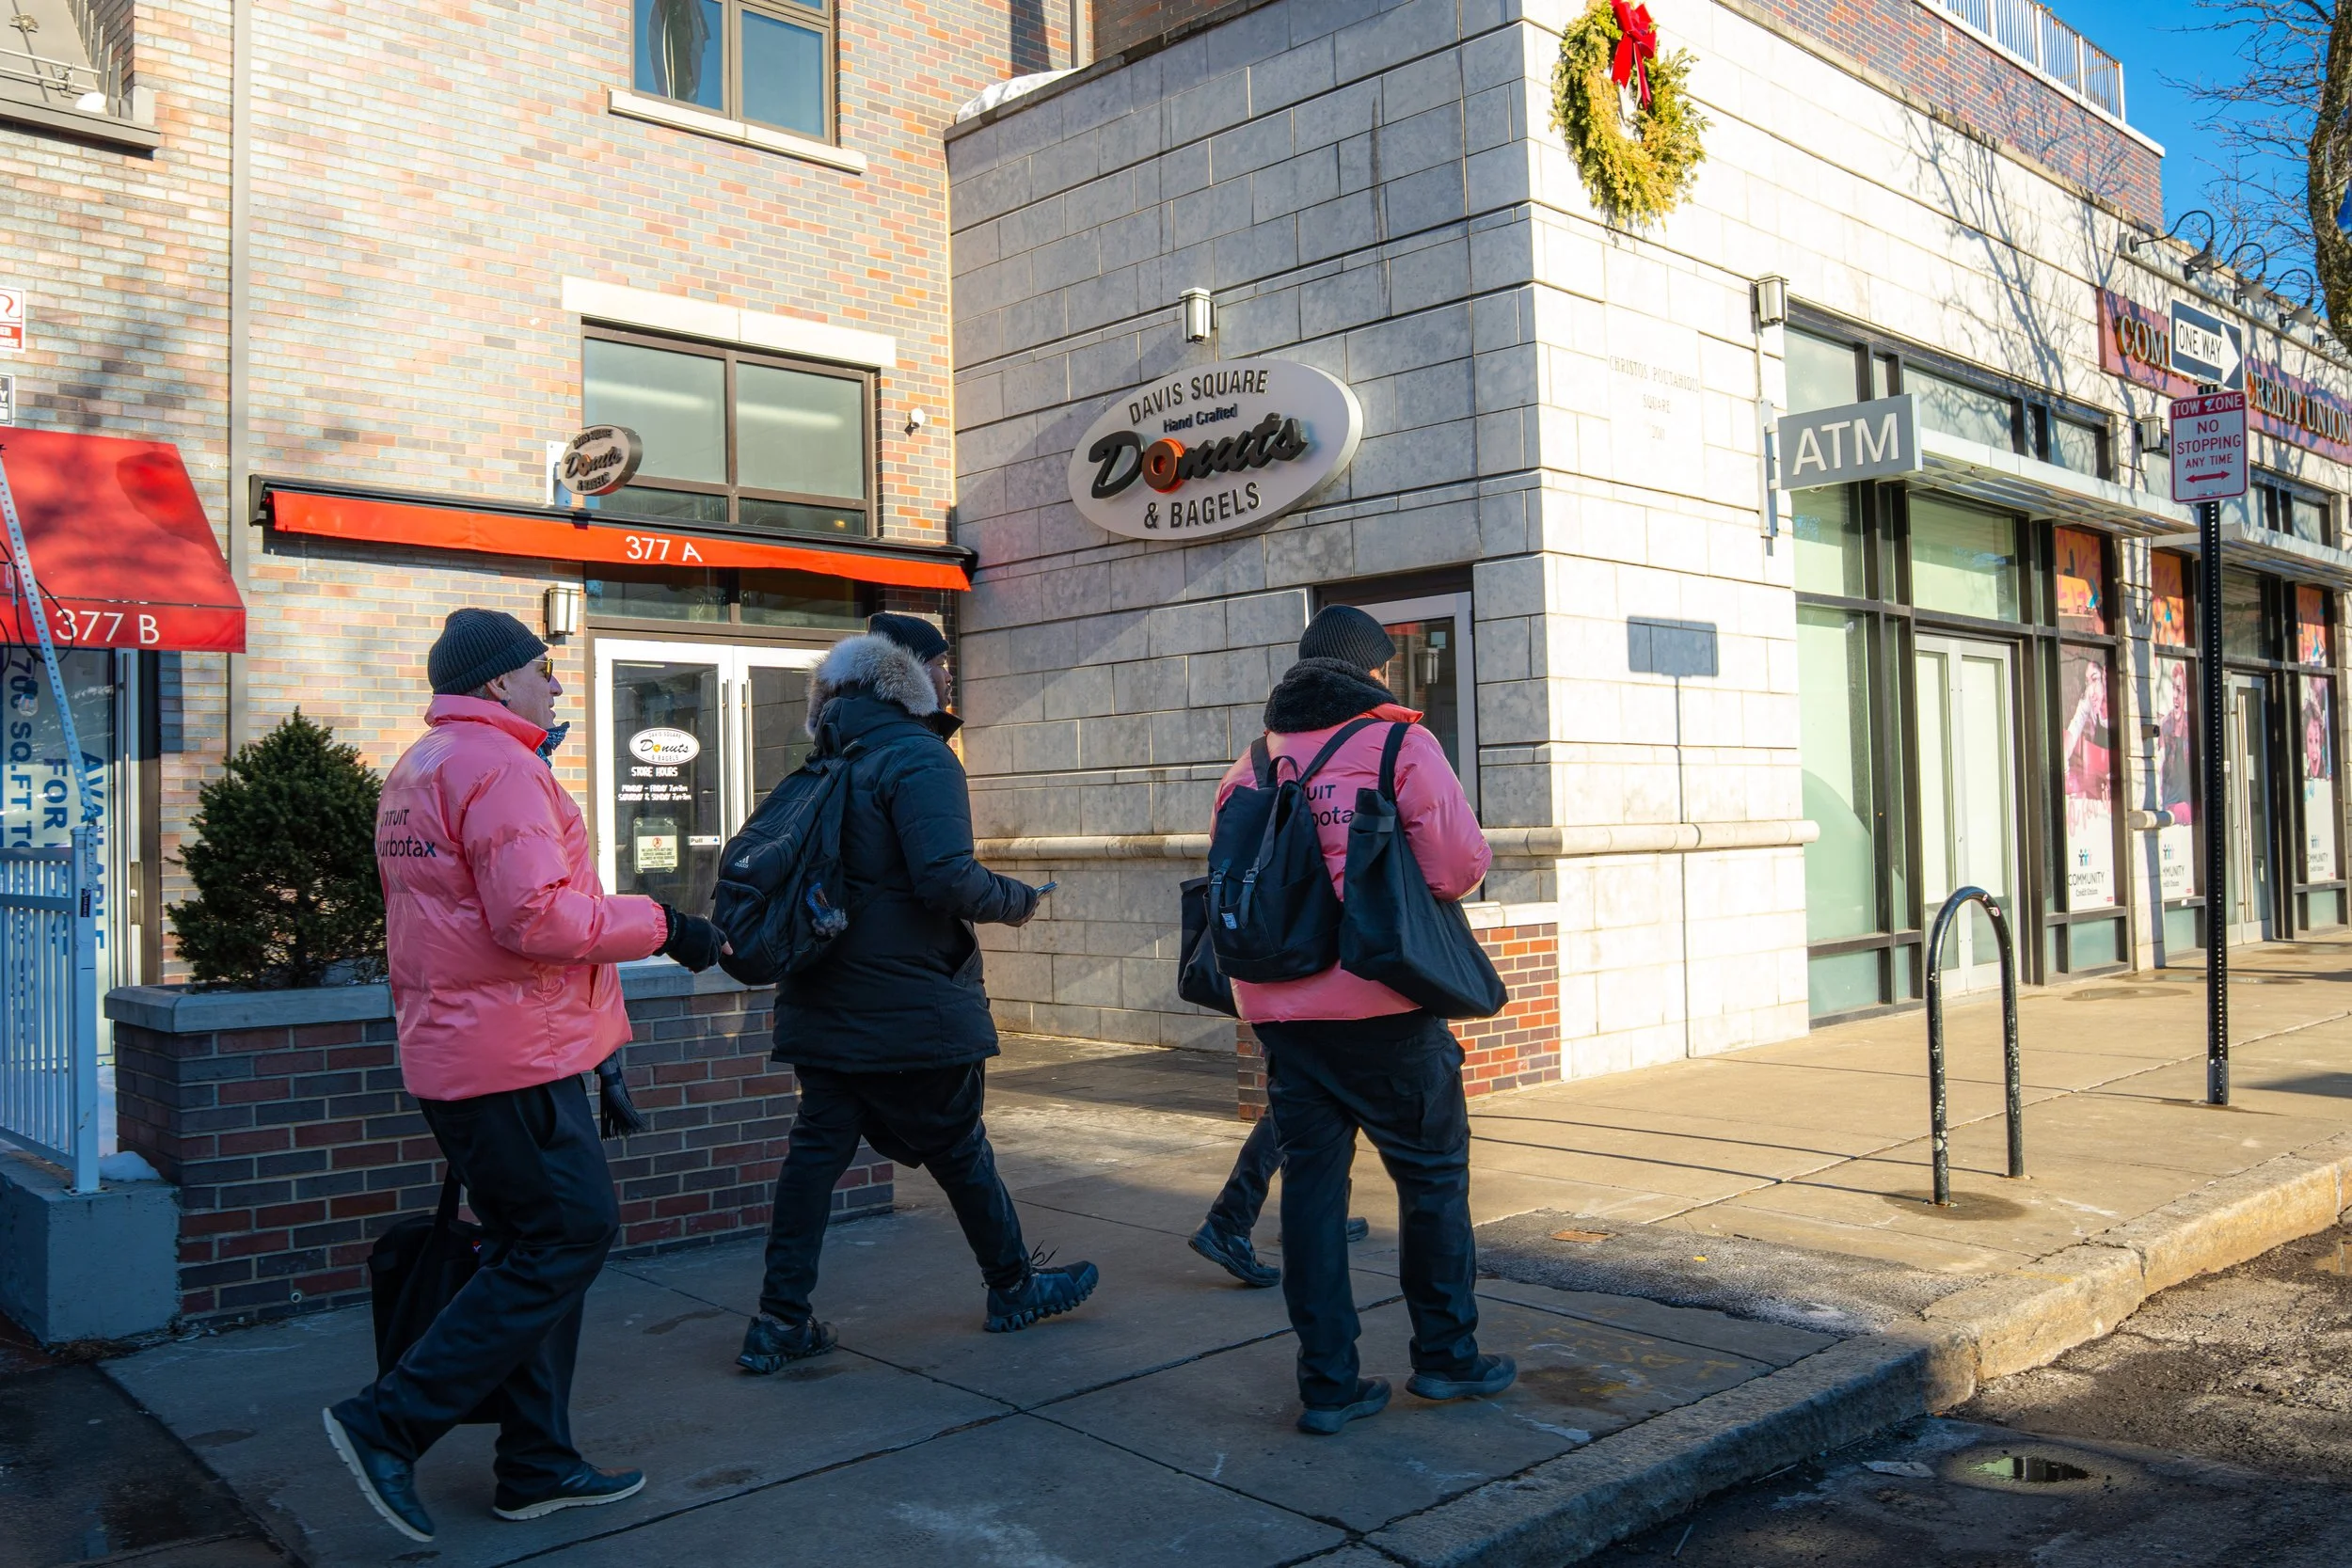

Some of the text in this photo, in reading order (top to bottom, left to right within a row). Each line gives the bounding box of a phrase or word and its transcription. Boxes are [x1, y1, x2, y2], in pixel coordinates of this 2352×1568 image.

[2179, 324, 2223, 364] ONE WAY
[1610, 356, 1647, 379] CHRISTOS
[1129, 370, 1269, 426] DAVIS SQUARE
[1643, 394, 1671, 414] SQUARE
[2173, 393, 2243, 416] TOW ZONE
[2246, 370, 2302, 424] CREDIT
[2304, 395, 2351, 444] UNION
[1163, 404, 1238, 434] Hand Crafted
[2198, 420, 2219, 435] NO
[1089, 412, 1309, 499] Donuts
[1792, 412, 1899, 476] ATM
[2177, 434, 2241, 455] STOPPING
[2185, 453, 2233, 468] ANY TIME
[1143, 482, 1261, 530] & BAGELS
[626, 535, 704, 562] 377 A
[55, 609, 160, 644] 377 B
[641, 739, 689, 752] Donuts
[8, 721, 32, 810] SQ.FT
[631, 767, 678, 777] STORE HOURS
[43, 758, 68, 830] FOR
[1306, 784, 1336, 800] UIT
[380, 832, 437, 857] urbotax
[2068, 871, 2105, 886] COMMUNITY
